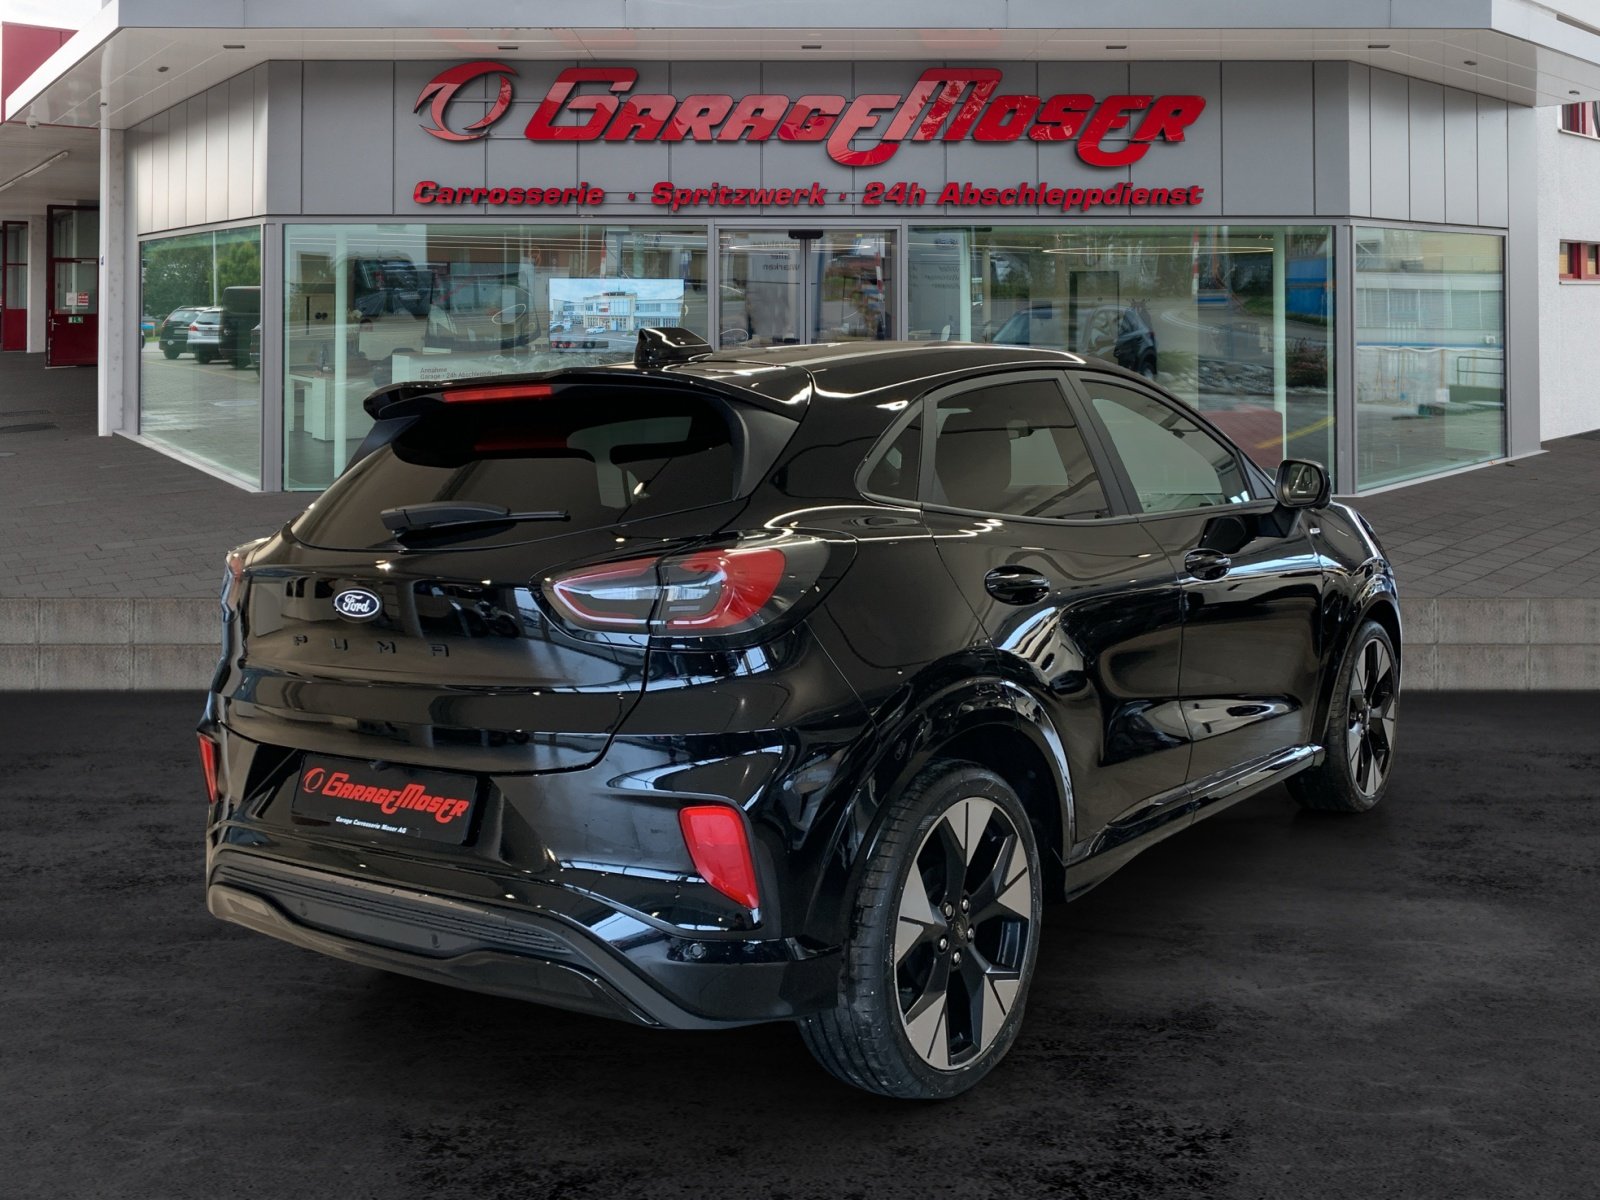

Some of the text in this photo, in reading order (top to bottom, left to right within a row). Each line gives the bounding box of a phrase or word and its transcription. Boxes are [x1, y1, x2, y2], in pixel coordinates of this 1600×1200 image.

[413, 181, 1204, 211] Carrosserie Spritzwerk 24h Abschleppdienst
[295, 635, 449, 657] PUMA
